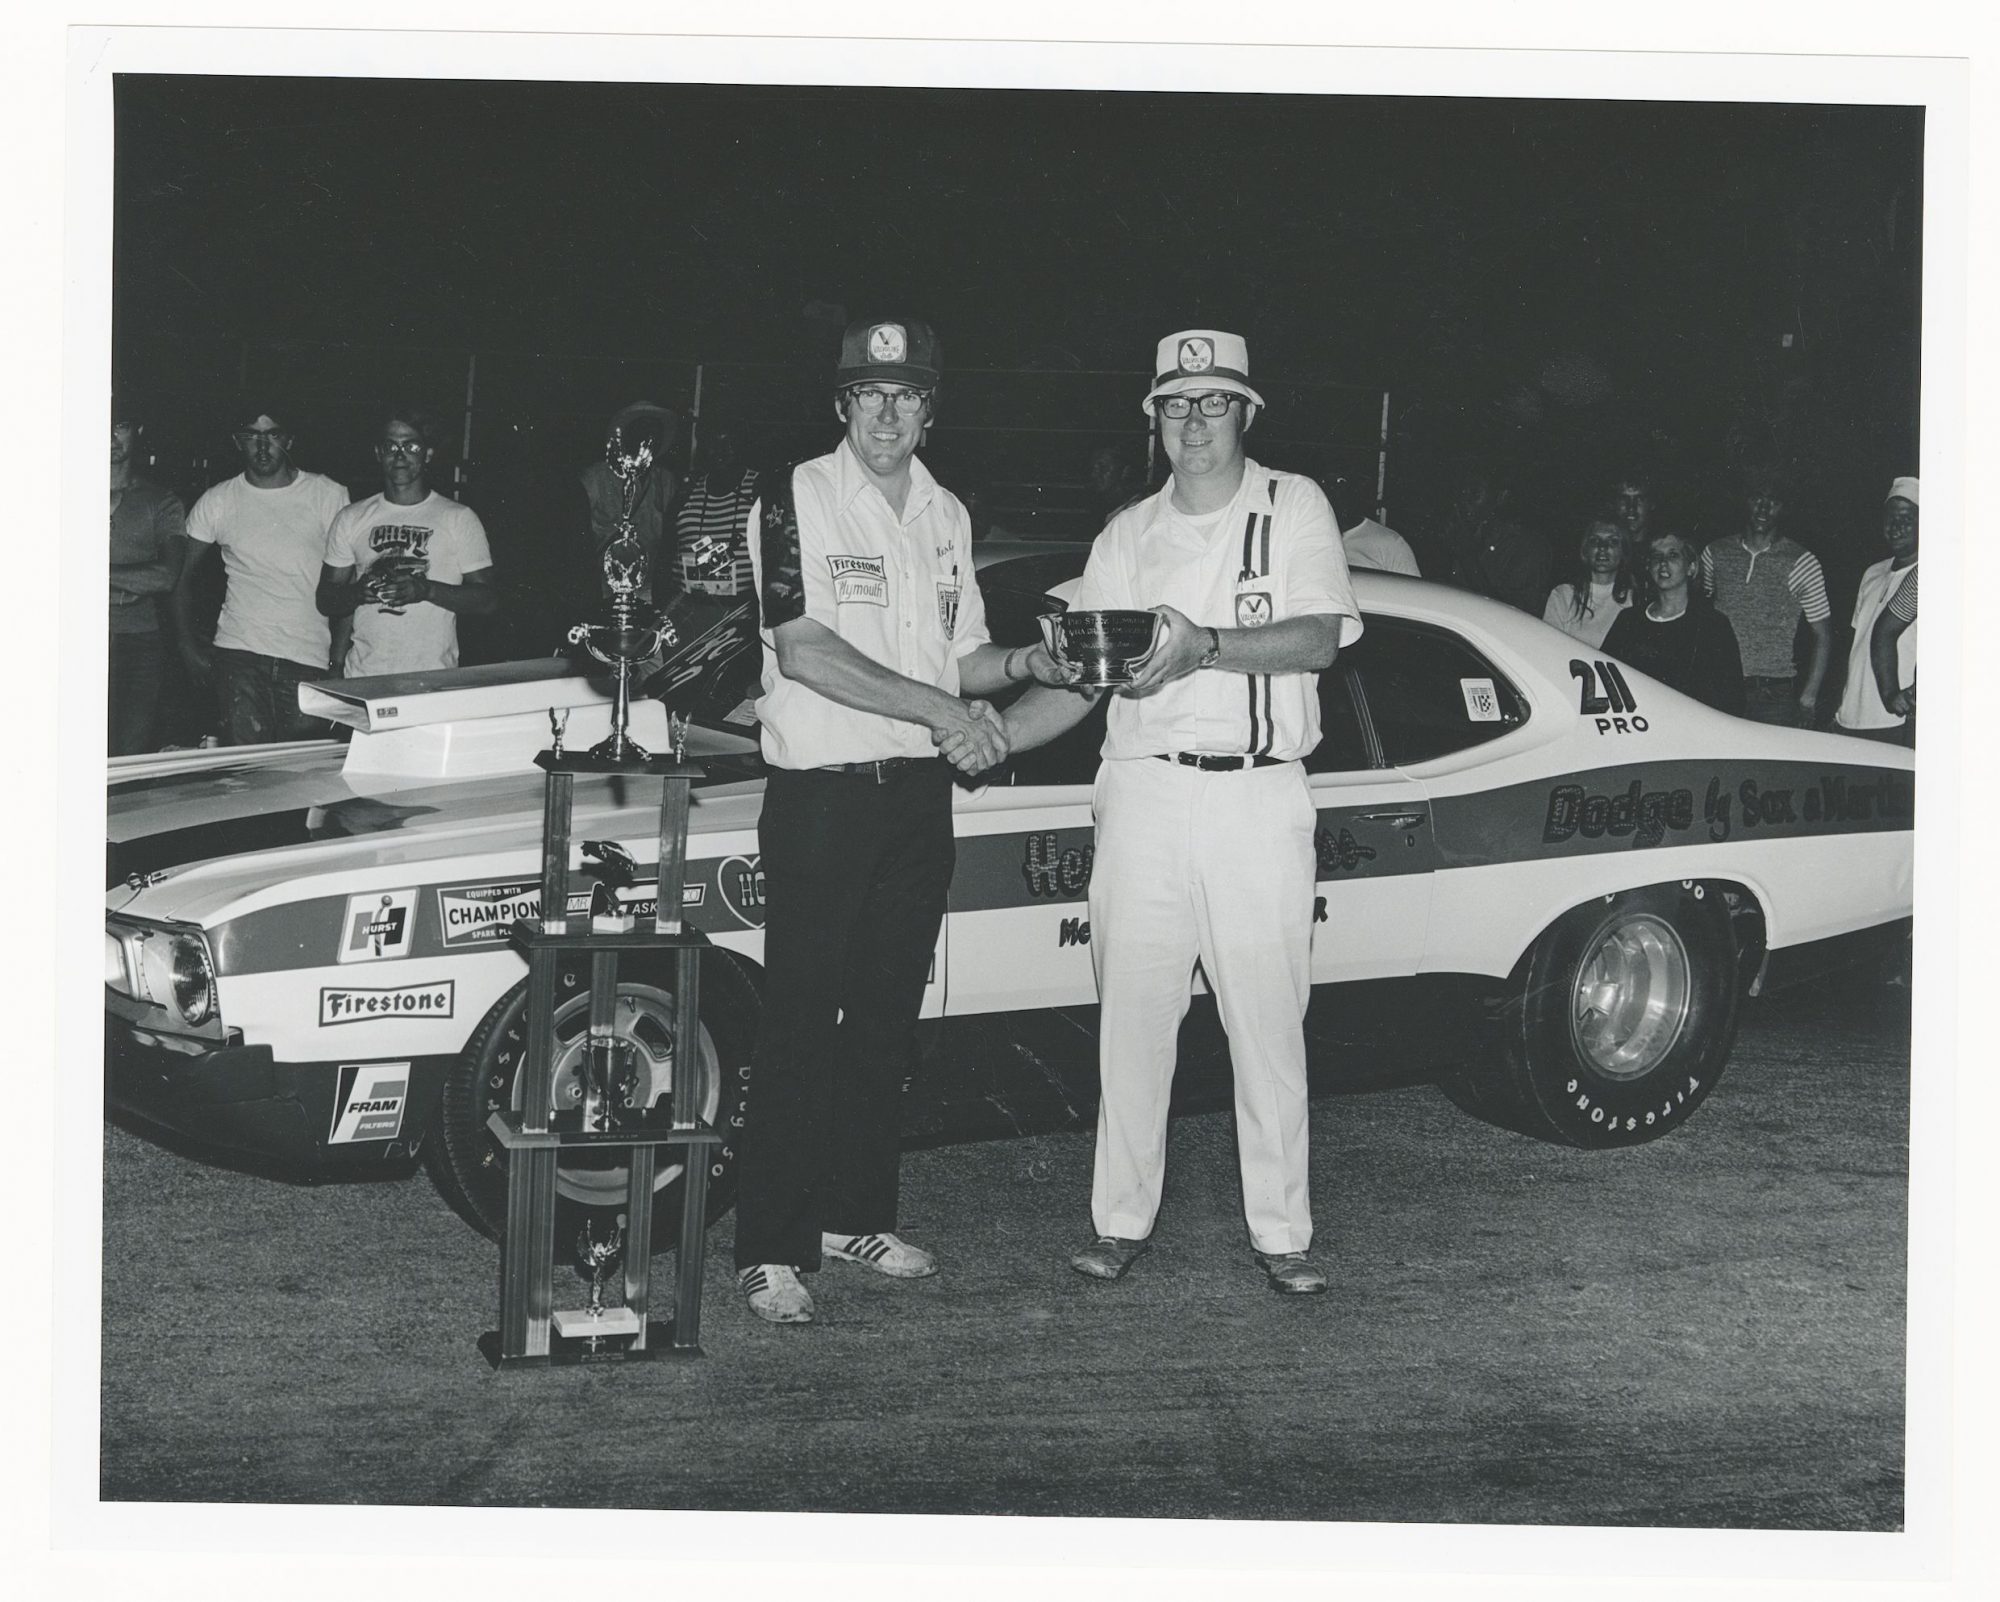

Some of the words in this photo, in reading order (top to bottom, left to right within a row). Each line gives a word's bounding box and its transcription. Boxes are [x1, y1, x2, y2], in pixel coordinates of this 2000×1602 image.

[833, 559, 881, 573] Firestone
[838, 580, 883, 599] Plymouth
[1569, 659, 1637, 715] 211
[1594, 715, 1649, 736] PRO
[1542, 779, 1694, 849] Dodge
[466, 889, 501, 899] EQUIPPED
[503, 887, 522, 896] WITH
[448, 900, 541, 925] CHAMPION
[362, 921, 398, 935] HURST
[472, 929, 496, 939] SPARK
[327, 993, 446, 1018] Firestone
[348, 1100, 398, 1114] FRAM
[1566, 1077, 1700, 1132] Firestone
[360, 1121, 396, 1130] FILTERS
